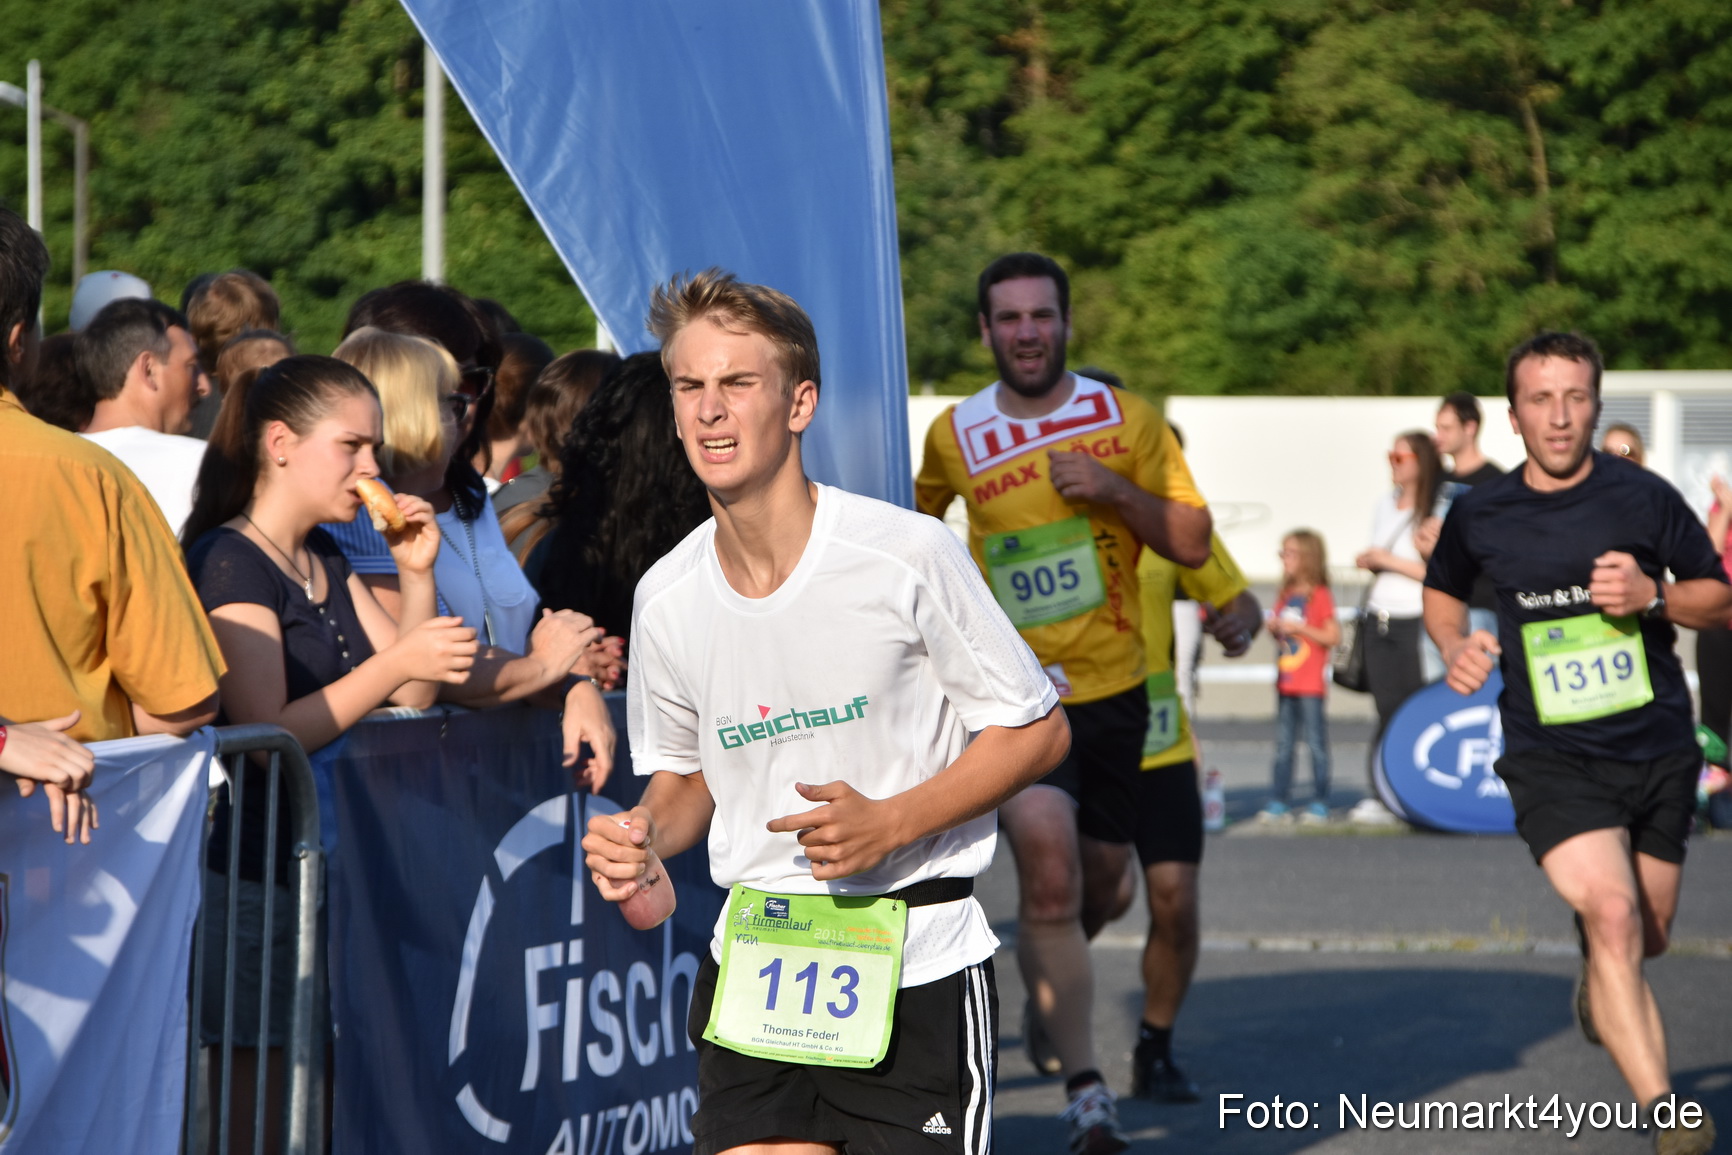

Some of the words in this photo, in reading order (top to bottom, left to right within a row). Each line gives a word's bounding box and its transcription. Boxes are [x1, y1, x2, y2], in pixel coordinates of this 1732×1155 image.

[973, 461, 1042, 504] MAX
[1069, 436, 1130, 459] ÖGL
[1010, 558, 1081, 602] 905
[1553, 589, 1571, 607] &
[1544, 650, 1634, 693] 1319
[716, 715, 732, 726] BGN
[717, 695, 869, 750] Gleichauf
[770, 731, 816, 747] Haustechnik
[753, 914, 813, 931] firmenlauf
[813, 927, 846, 942] 2015
[759, 957, 860, 1018] 113
[762, 1023, 804, 1038] Thomas
[806, 1028, 839, 1041] Federl
[765, 1038, 791, 1047] Gleichauf
[922, 1126, 952, 1135] adidas
